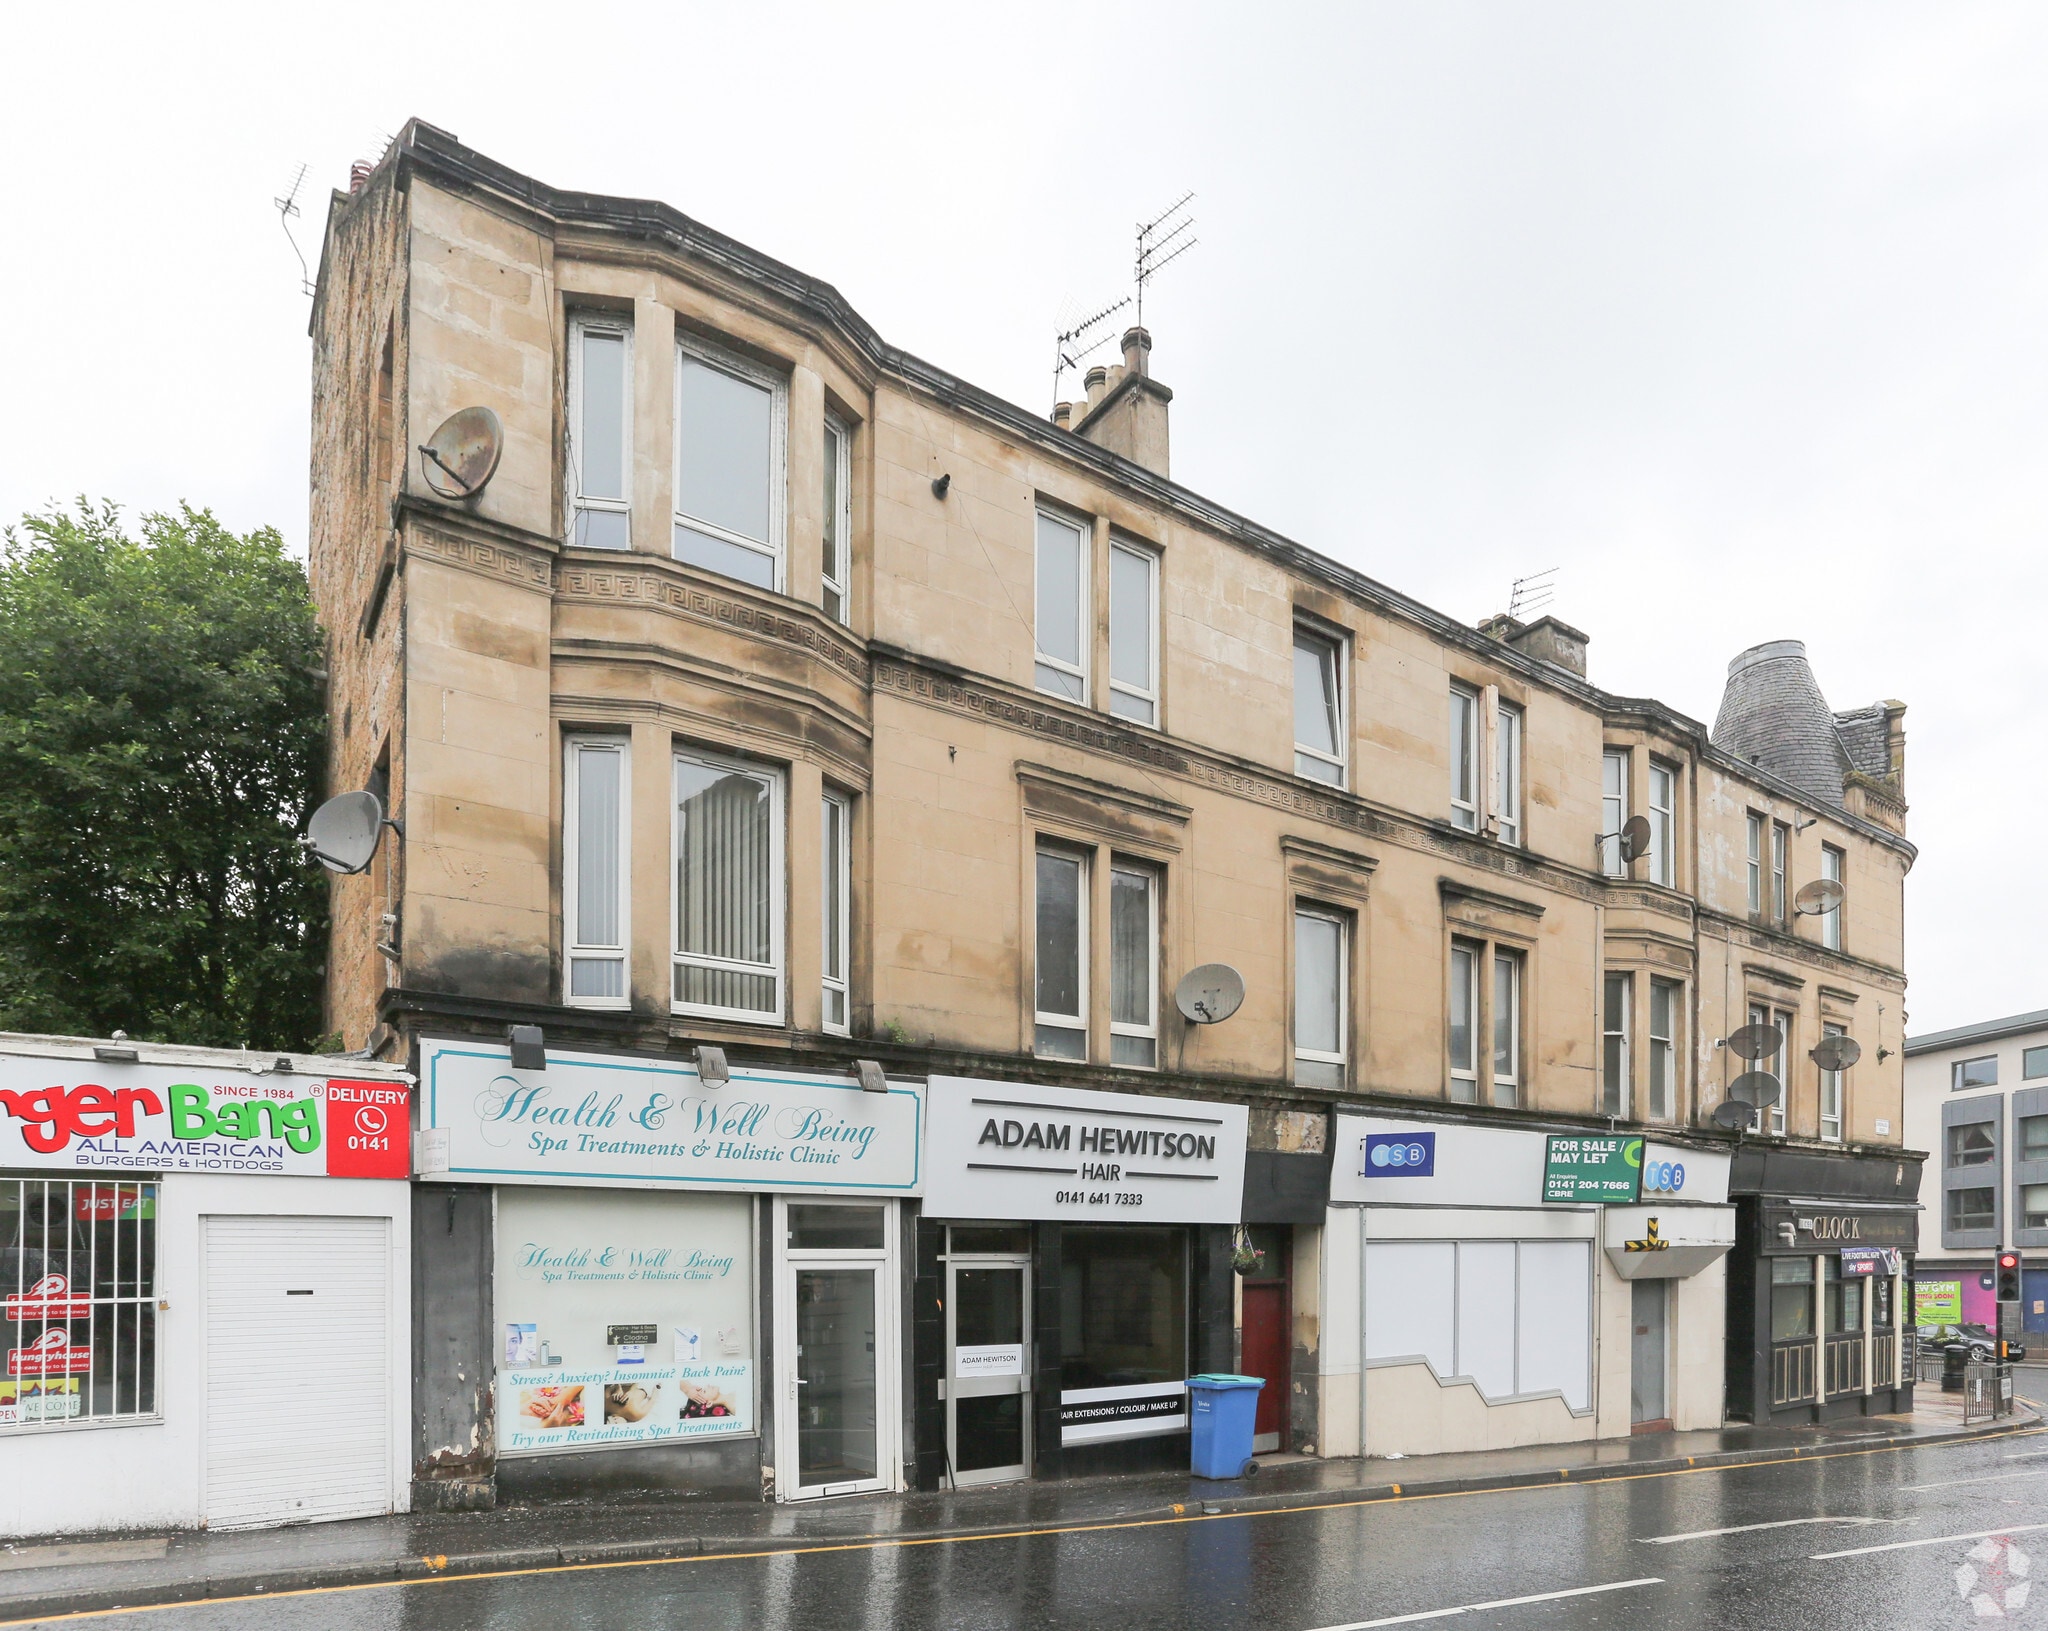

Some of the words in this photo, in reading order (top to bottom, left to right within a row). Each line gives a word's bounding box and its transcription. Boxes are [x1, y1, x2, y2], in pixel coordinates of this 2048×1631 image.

[213, 1085, 258, 1098] SINCE
[263, 1089, 294, 1099] 1984
[328, 1087, 408, 1105] DELIVERY
[168, 1084, 322, 1154] Bang
[474, 1075, 623, 1147] Health
[629, 1092, 674, 1131] &
[681, 1096, 770, 1137] Well
[774, 1106, 880, 1160] Being
[347, 1136, 389, 1151] 0141
[978, 1118, 1072, 1151] ADAM
[1080, 1126, 1216, 1160] HEWITSON
[1551, 1140, 1578, 1152] FOR
[1582, 1141, 1617, 1152] SALE
[76, 1138, 129, 1153] ALL
[138, 1140, 283, 1159] AMERICAN
[528, 1131, 569, 1157] Spa
[576, 1134, 685, 1157] Treatments
[691, 1139, 711, 1157] &
[715, 1142, 785, 1162] Holistic
[789, 1145, 841, 1165] Clinic
[76, 1154, 174, 1167] BURGERS
[179, 1158, 190, 1168] &
[196, 1159, 283, 1171] HOTDOGS
[1550, 1153, 1580, 1164] MAY
[1583, 1153, 1609, 1164] LET
[1082, 1162, 1121, 1181] HAIR
[1548, 1180, 1575, 1189] 0141
[1578, 1180, 1599, 1189] 204
[1602, 1181, 1630, 1190] 7666
[1055, 1190, 1085, 1205] 0141
[1089, 1192, 1110, 1205] 641
[1114, 1193, 1143, 1206] 7333
[1547, 1190, 1574, 1198] CBRE
[81, 1199, 115, 1211] JUST
[122, 1199, 150, 1209] EAT
[1813, 1216, 1860, 1240] CLOCK
[514, 1243, 591, 1269] Health
[594, 1246, 619, 1267] &
[622, 1248, 672, 1268] Well
[676, 1249, 734, 1277] Being
[1848, 1263, 1857, 1273] sky
[1857, 1262, 1874, 1271] SPORTS
[542, 1270, 562, 1284] Spa
[567, 1270, 625, 1280] Treatments
[628, 1269, 639, 1280] &
[641, 1270, 681, 1280] Holistic
[683, 1270, 714, 1280] Clinic
[1932, 1284, 1955, 1292] GYM
[961, 1356, 982, 1364] ADAM
[983, 1355, 1017, 1363] HEWITSON
[510, 1373, 554, 1386] Stress?
[556, 1371, 611, 1386] Anxiety?
[613, 1368, 676, 1381] Insomnia?
[682, 1366, 711, 1378] Back
[714, 1365, 746, 1377] Pain?
[25, 1400, 78, 1412] WECOME
[1061, 1411, 1073, 1419] AIR
[1074, 1407, 1115, 1418] EXTENSIONS
[1120, 1404, 1146, 1414] COLOUR
[1150, 1402, 1168, 1410] MAKE
[1169, 1401, 1178, 1409] UP
[511, 1433, 534, 1448] Try
[538, 1434, 563, 1444] our
[566, 1427, 645, 1442] Revitalising
[648, 1424, 671, 1439] Spa
[676, 1421, 743, 1434] Treatments
